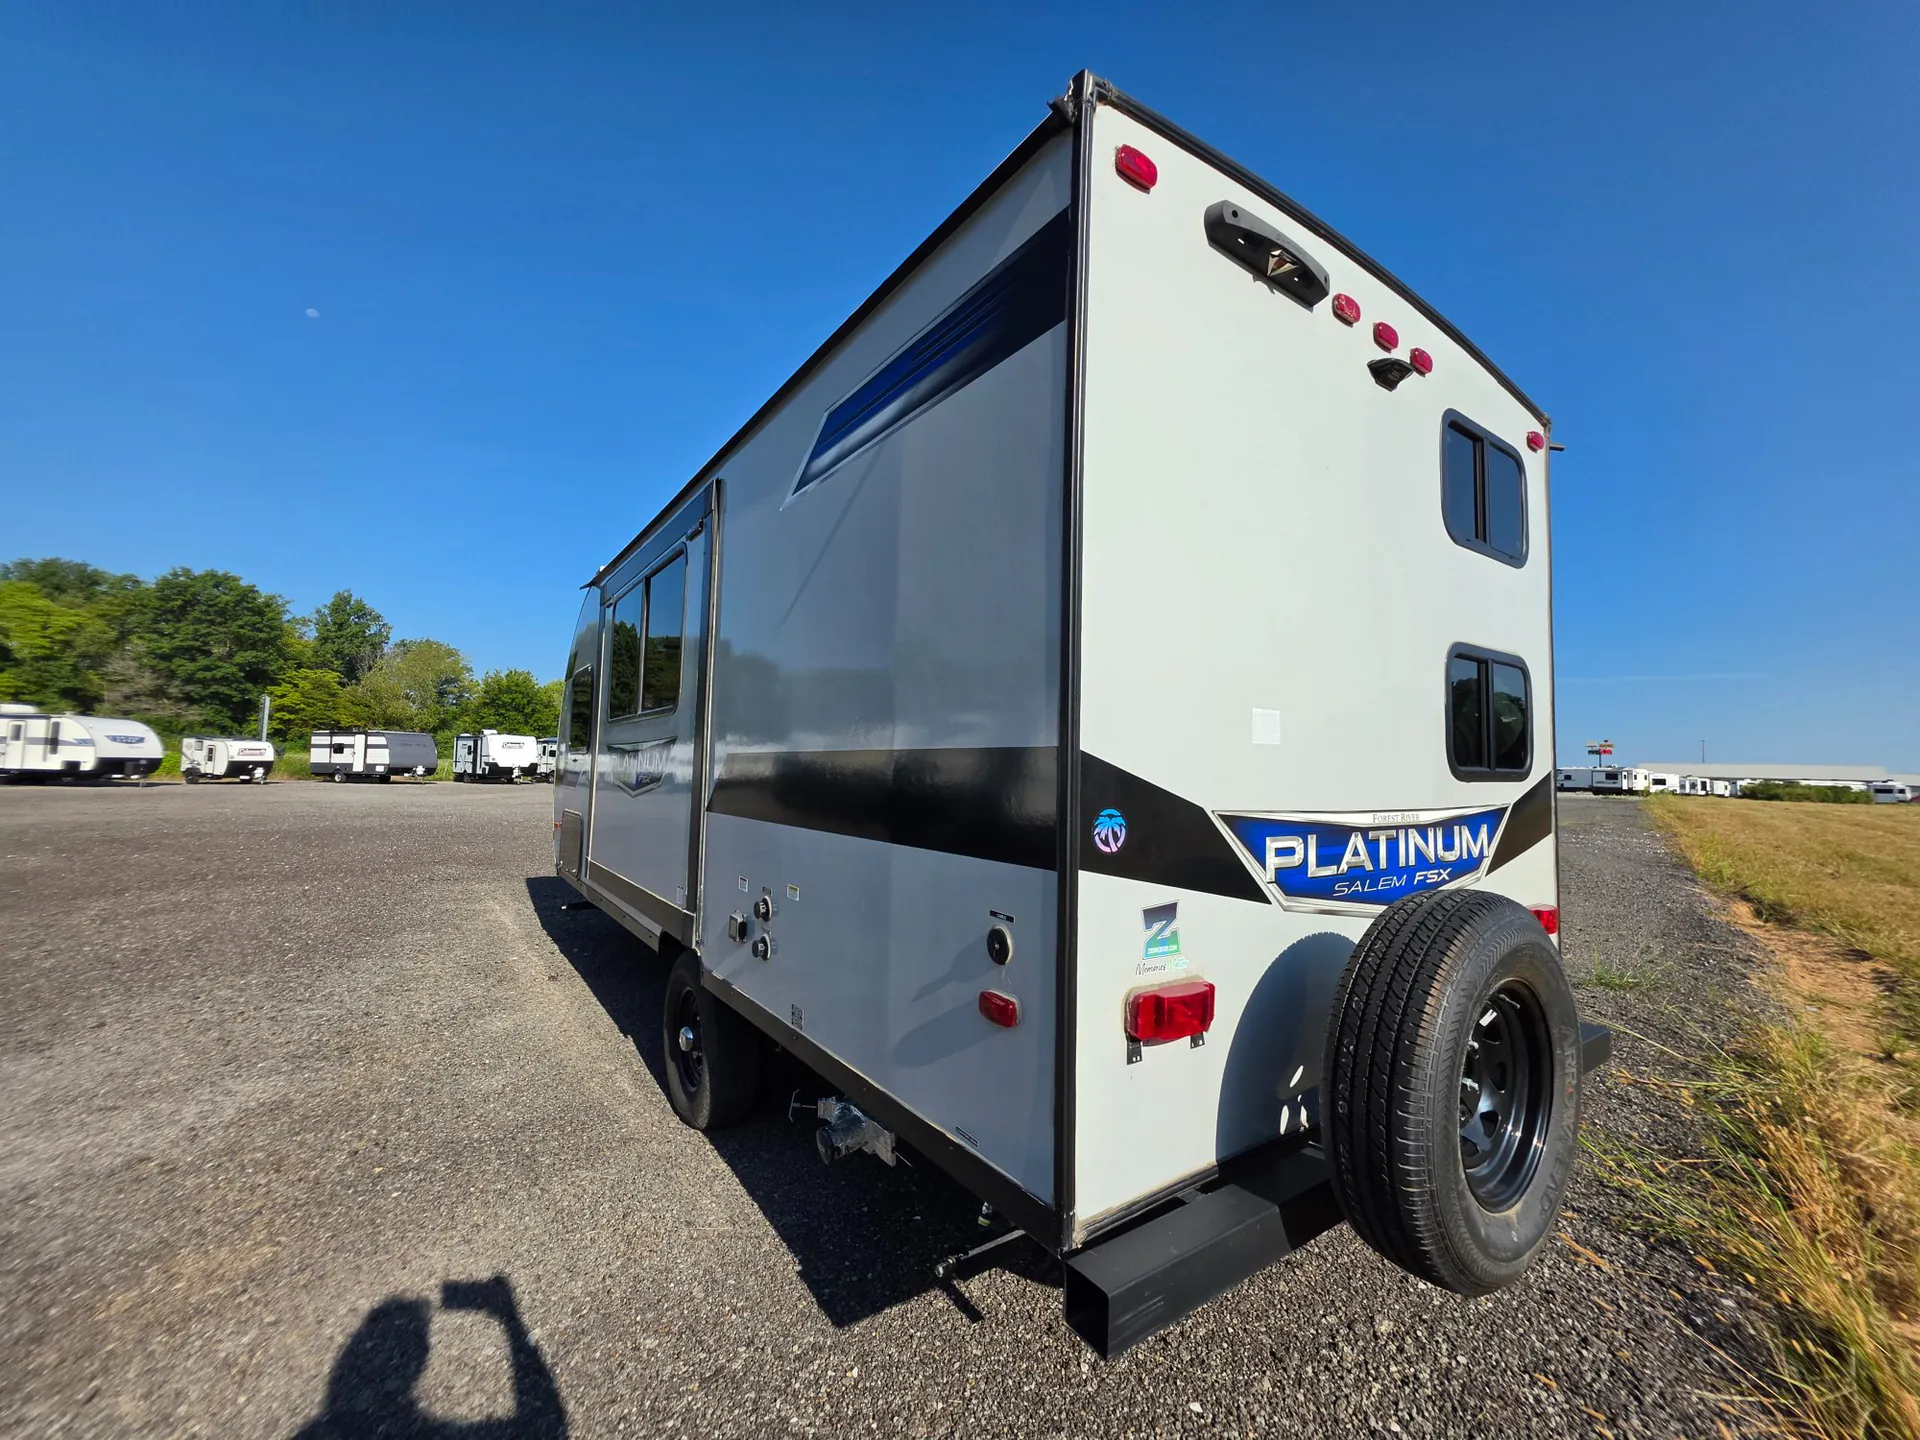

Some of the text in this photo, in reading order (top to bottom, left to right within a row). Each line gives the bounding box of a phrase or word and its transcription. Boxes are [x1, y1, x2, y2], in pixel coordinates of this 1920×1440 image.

[1372, 813, 1420, 823] FOREST RIVER
[1265, 823, 1489, 884] PLATINUM
[1333, 868, 1452, 896] SALEM FSX
[1141, 901, 1180, 959] Z
